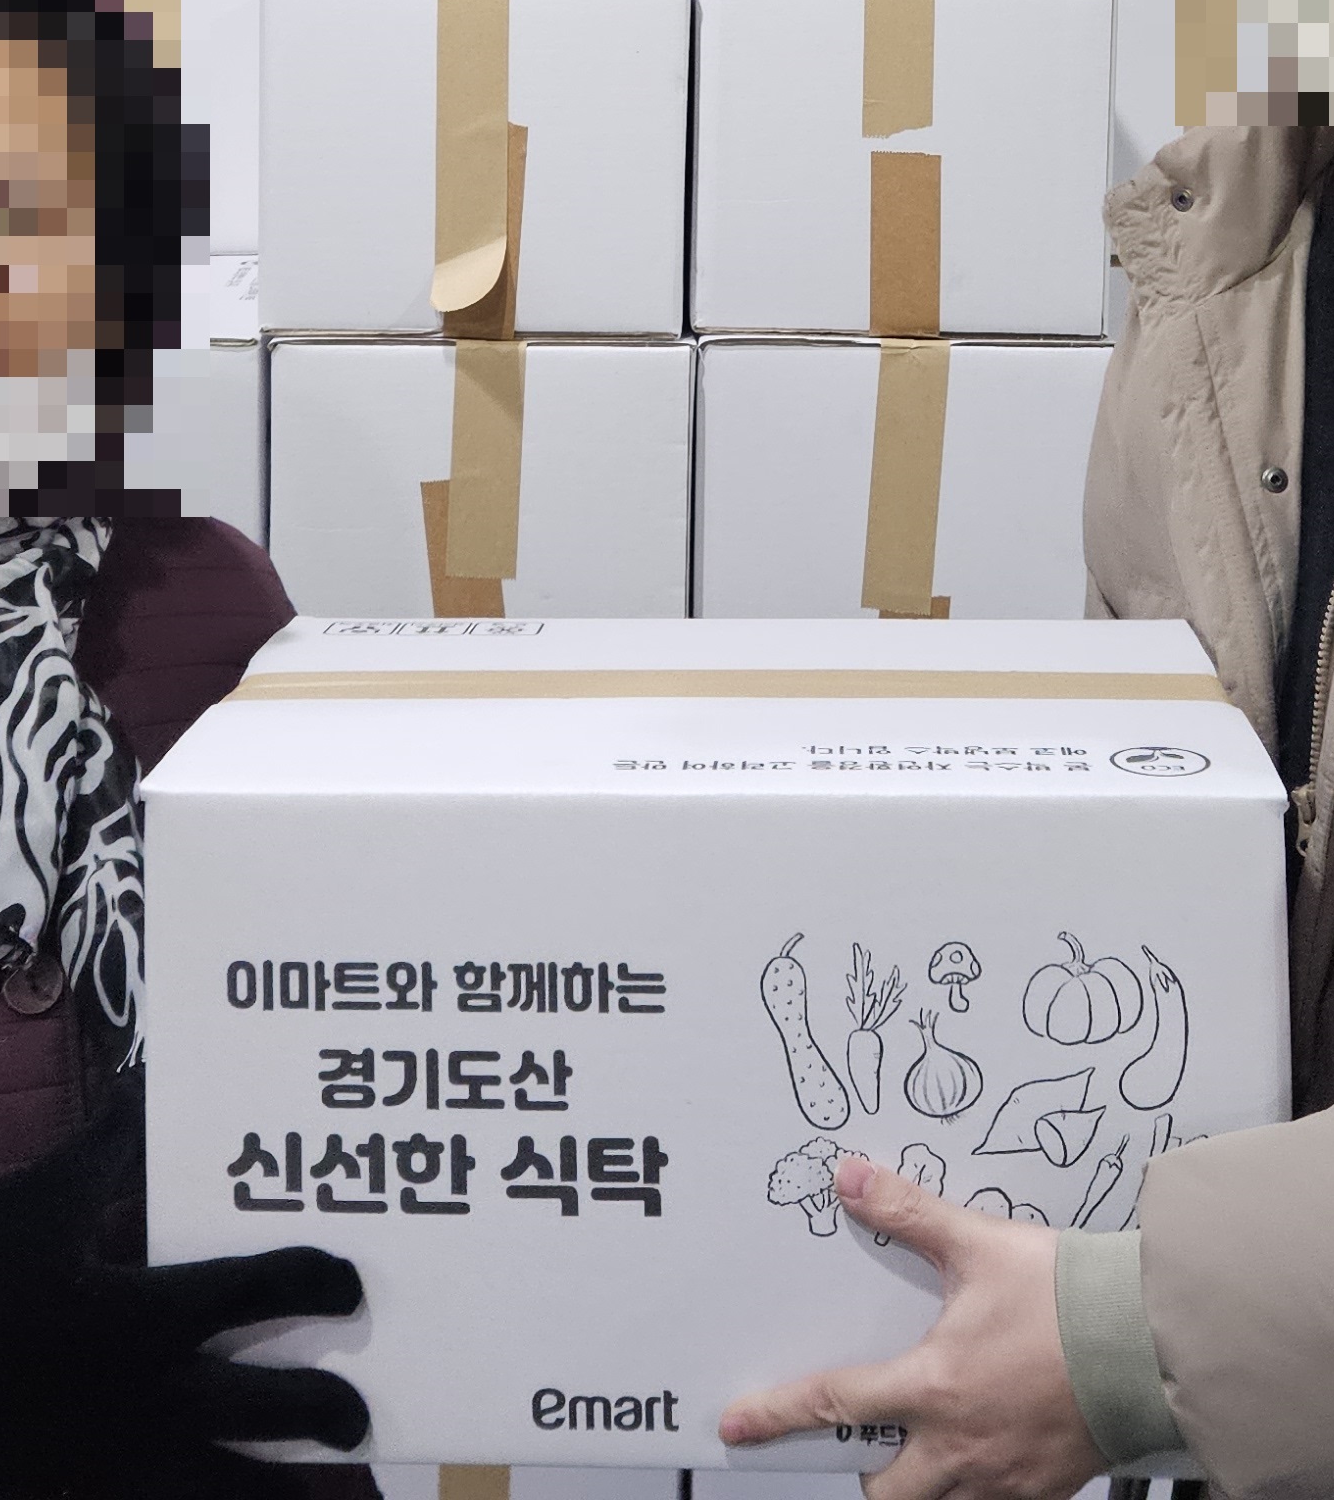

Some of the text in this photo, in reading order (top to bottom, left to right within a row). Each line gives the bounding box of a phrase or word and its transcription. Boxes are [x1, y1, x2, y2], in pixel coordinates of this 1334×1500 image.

[613, 760, 1092, 772] 본 박스는 자연환경을 고려하여 만든
[802, 745, 1087, 756] 에코 보냉박스 입니다.
[226, 960, 667, 1014] 이마트와 함께하는
[318, 1047, 573, 1111] 경기도산
[226, 1131, 669, 1217] 신선한 식탁
[532, 1388, 679, 1432] emart
